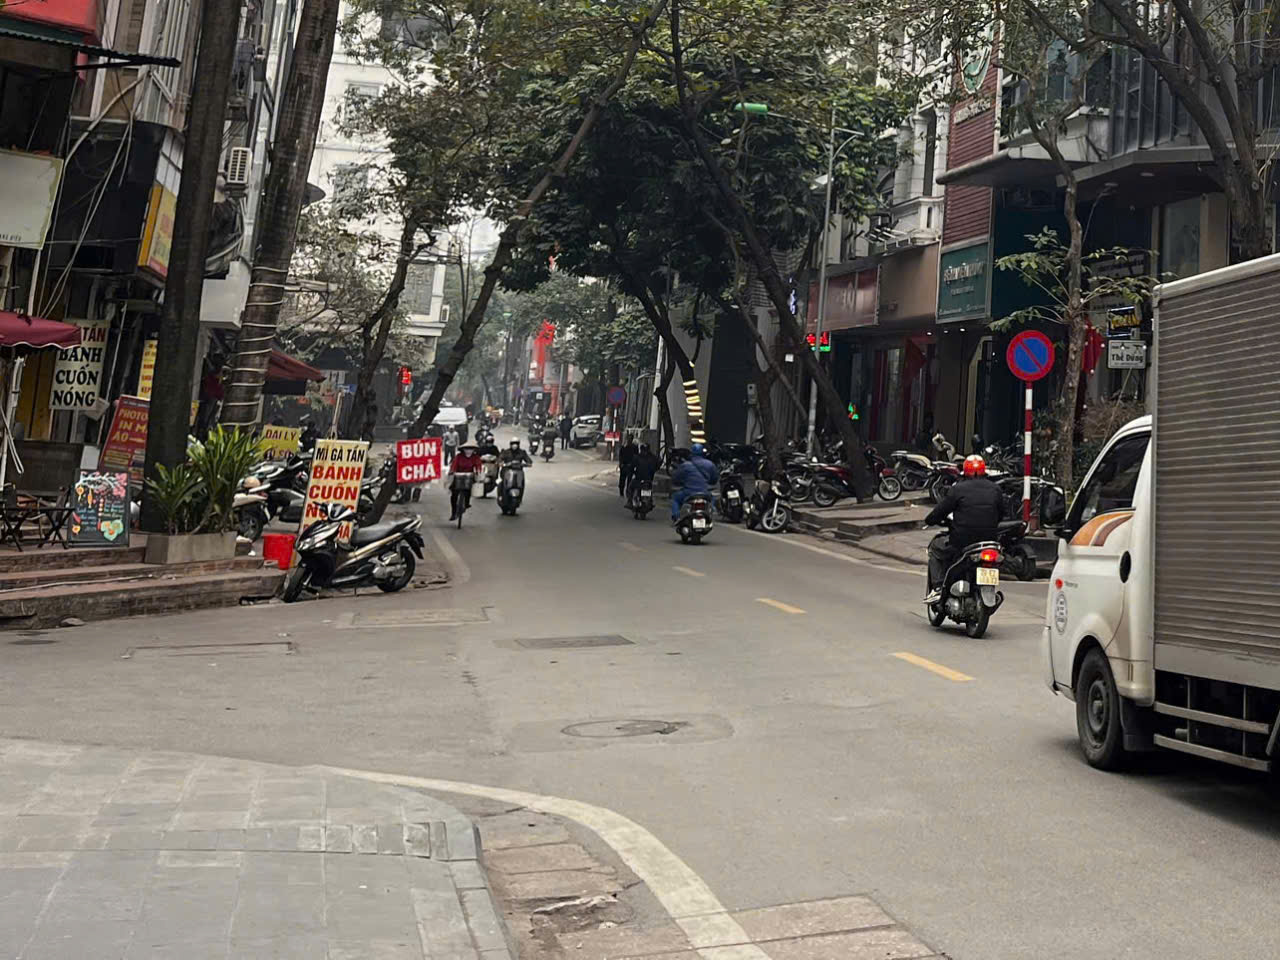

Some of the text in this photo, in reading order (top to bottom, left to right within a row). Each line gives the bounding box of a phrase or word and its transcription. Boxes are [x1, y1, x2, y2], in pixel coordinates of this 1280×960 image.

[55, 364, 99, 385] CUỐN
[52, 386, 96, 407] NÓNG
[331, 445, 344, 461] GÀ
[401, 440, 436, 458] BÚN
[313, 462, 362, 480] BÁNH
[401, 459, 436, 480] CHẢ
[309, 481, 358, 500] CUỐN
